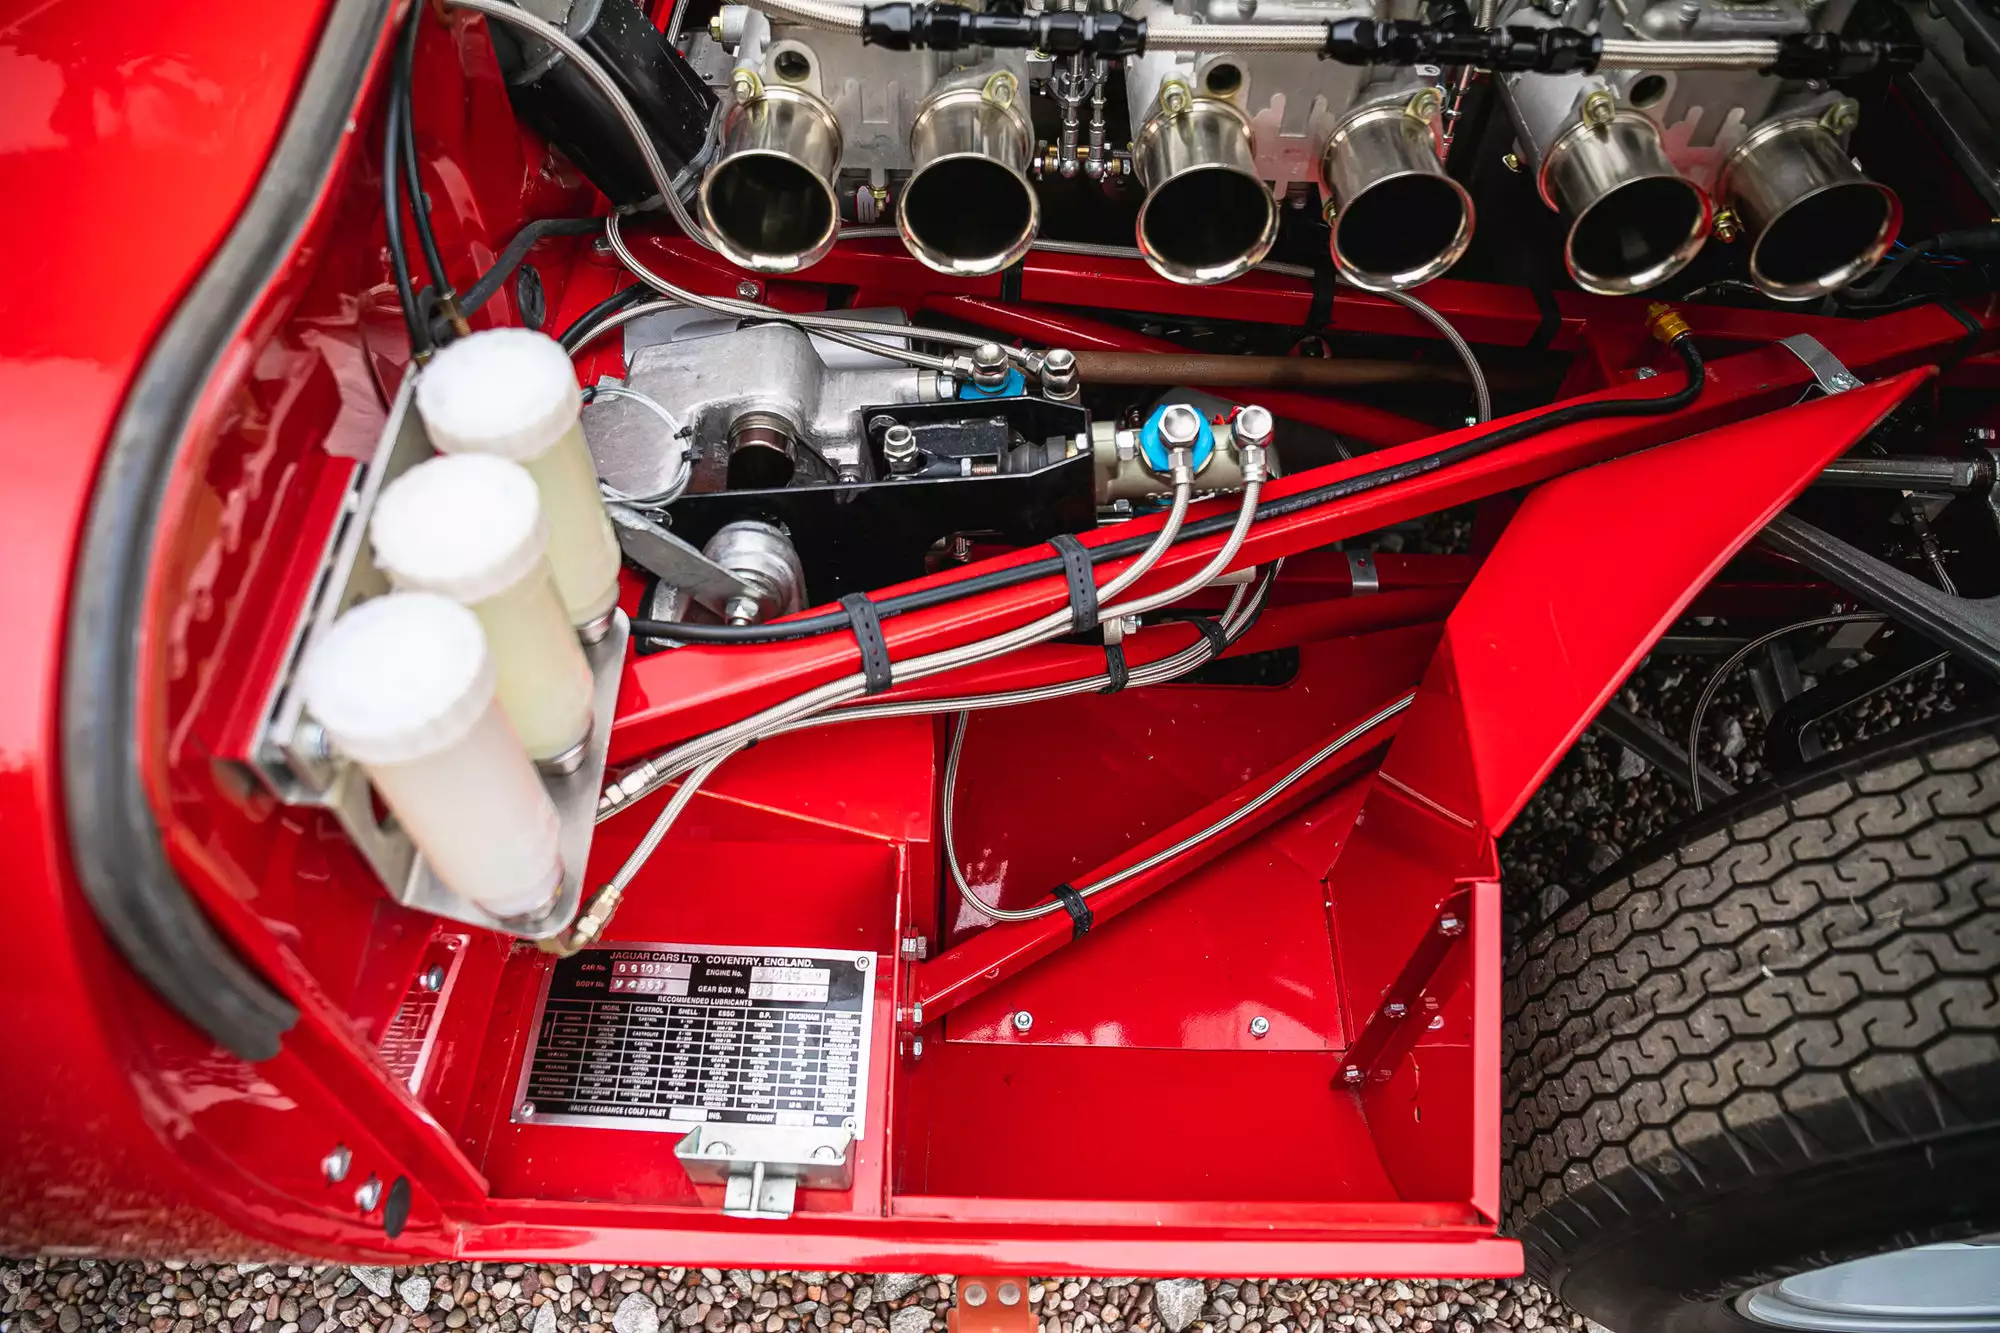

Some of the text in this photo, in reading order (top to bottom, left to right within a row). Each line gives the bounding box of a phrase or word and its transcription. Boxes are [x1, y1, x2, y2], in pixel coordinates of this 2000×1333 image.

[609, 951, 814, 968] JAGUAR CARS LTD. COVENTRY, ENGLAND.
[705, 968, 731, 977] ENGINE
[731, 969, 743, 978] No.
[697, 985, 717, 993] GEAR
[718, 986, 733, 994] BOX
[735, 986, 747, 995] No.
[657, 995, 753, 1007] RECOMMENDED LUBRICANTS
[635, 1006, 664, 1014] CASTROL
[678, 1008, 698, 1016] SHELL
[717, 1010, 736, 1018] ESSO
[568, 1104, 588, 1113] VALVE
[588, 1105, 623, 1115] CLEARANCE
[648, 1108, 667, 1117] INLET
